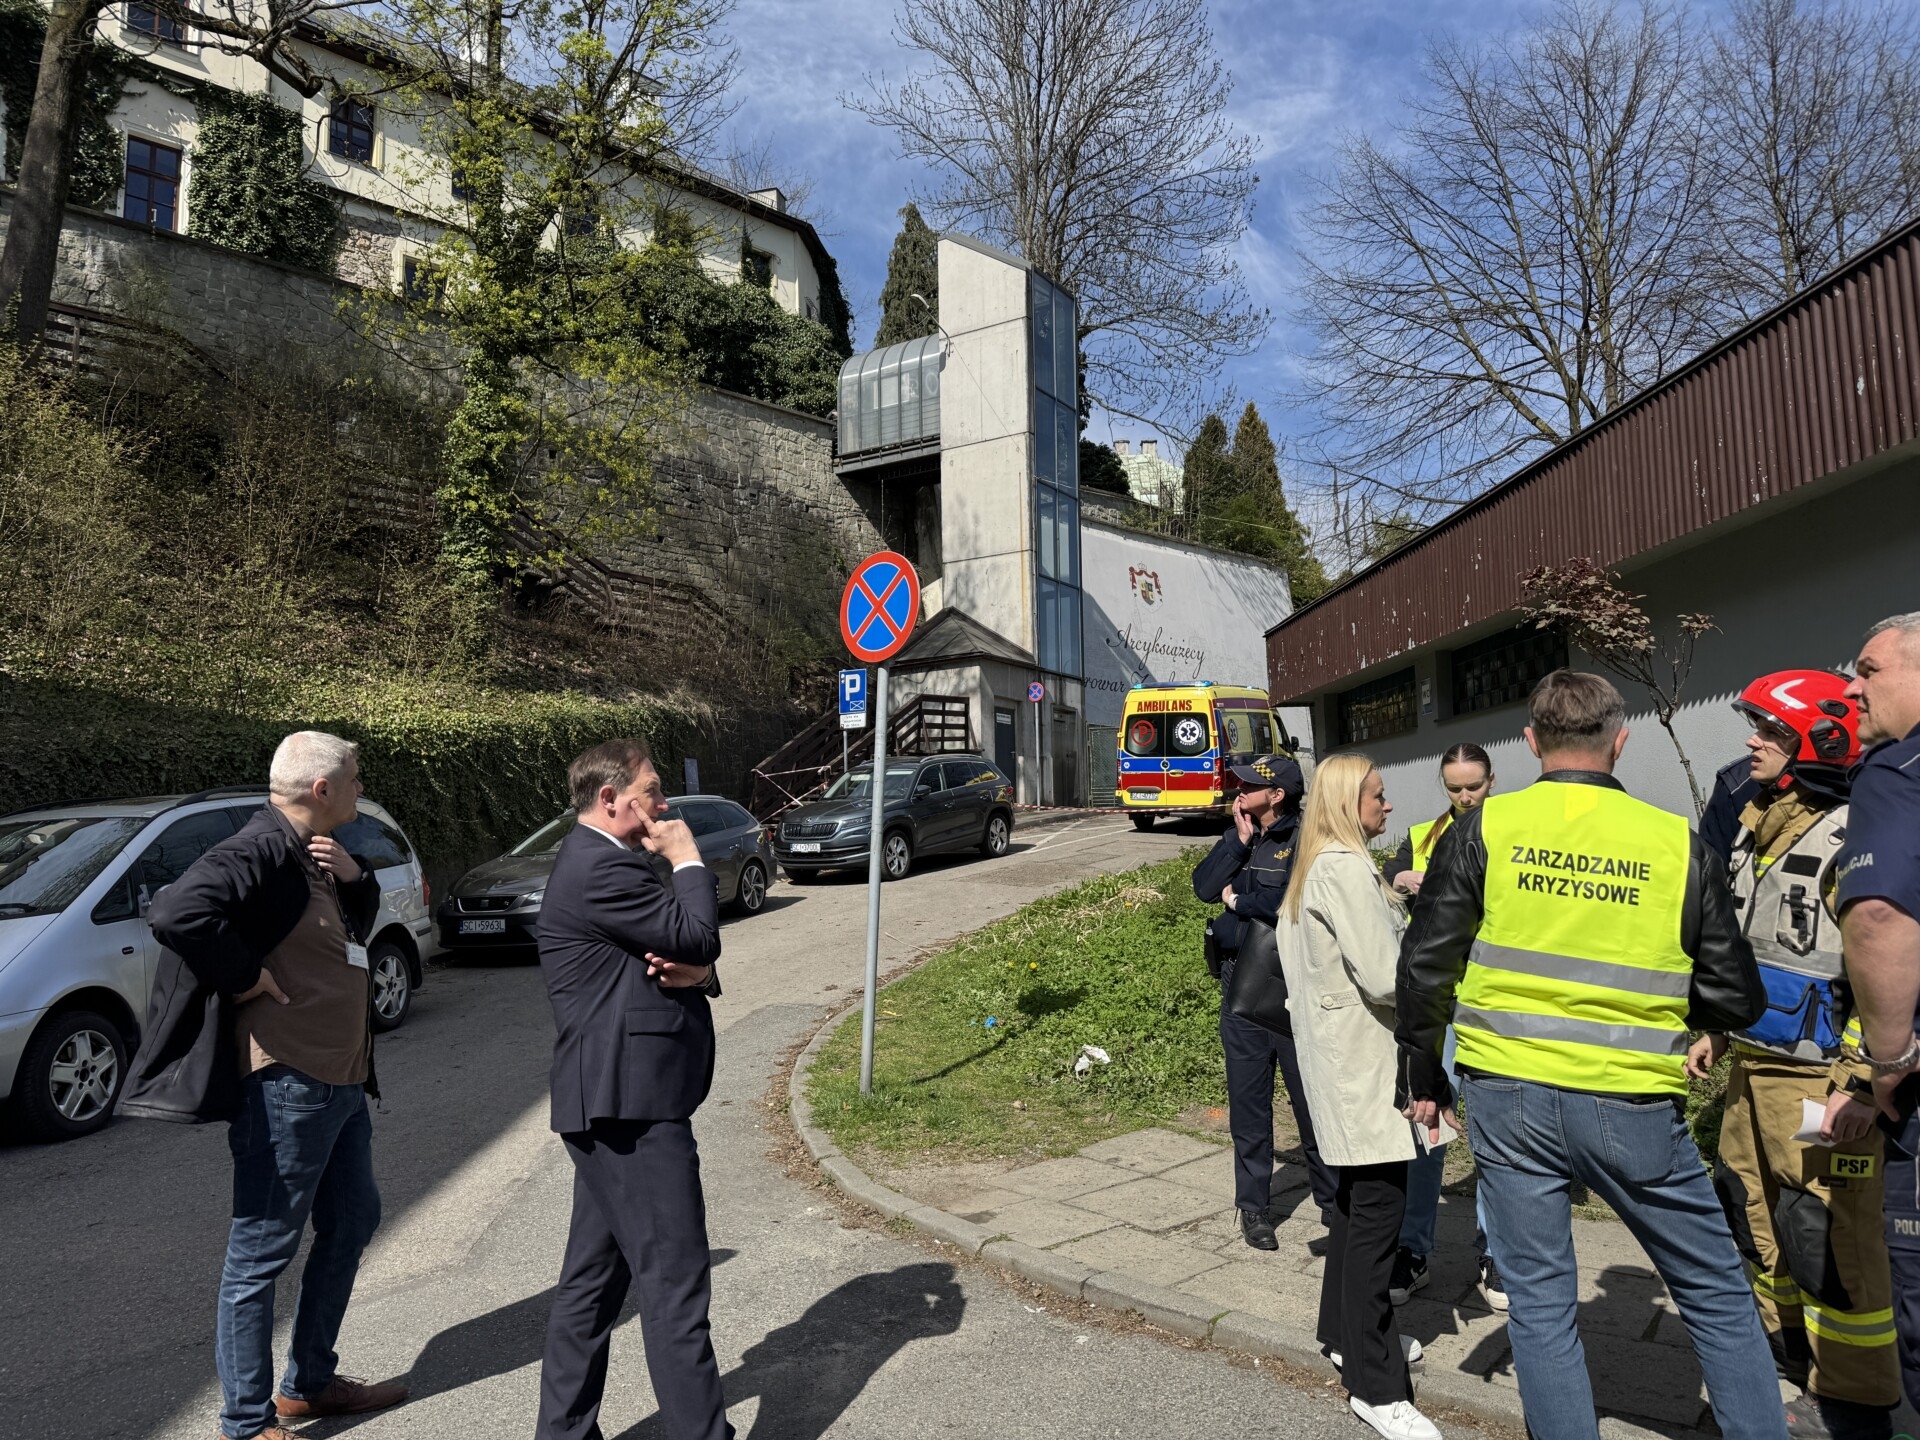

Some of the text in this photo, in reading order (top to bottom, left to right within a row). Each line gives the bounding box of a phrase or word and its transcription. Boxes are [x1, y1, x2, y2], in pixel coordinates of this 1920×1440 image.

[845, 673, 861, 701] P
[1084, 676, 1126, 693] rowar
[1136, 699, 1193, 713] AMBULANS
[1511, 845, 1651, 881] ZARZĄDZANIE
[1517, 871, 1640, 906] KRYZYSOWE
[463, 920, 505, 931] SCI 5963L
[1836, 1157, 1869, 1174] PSP
[1893, 1217, 1920, 1236] POLI
